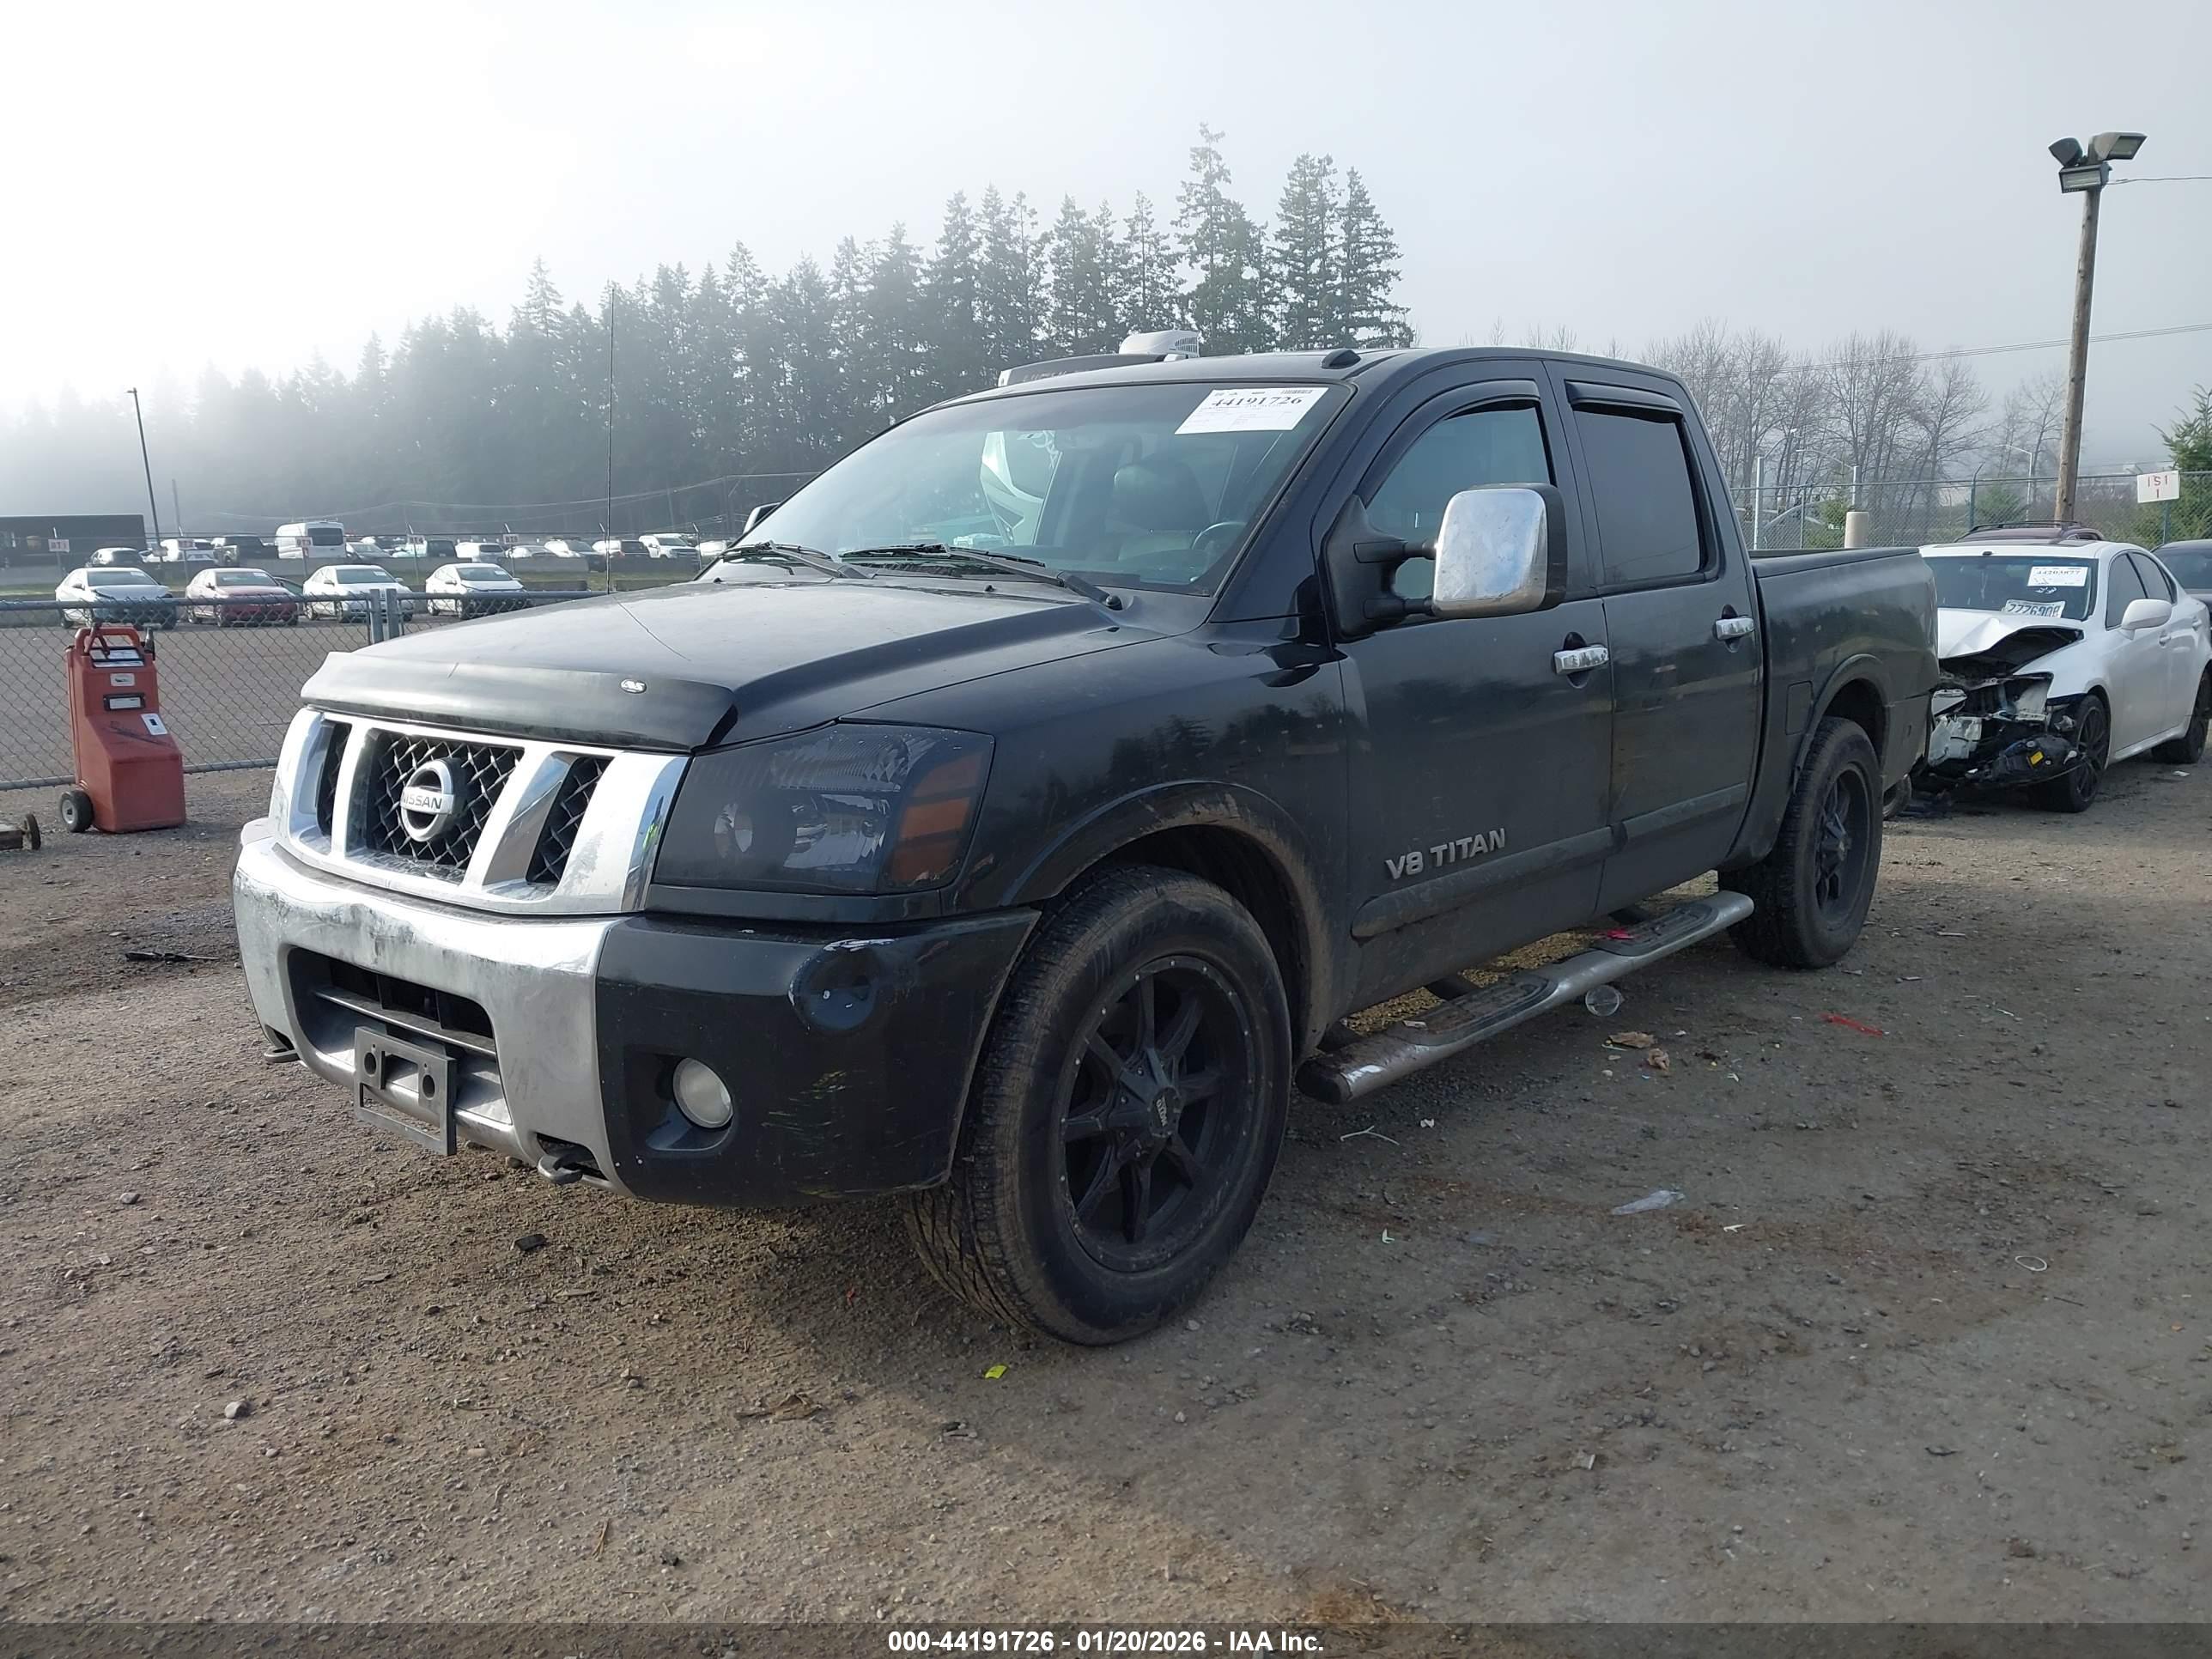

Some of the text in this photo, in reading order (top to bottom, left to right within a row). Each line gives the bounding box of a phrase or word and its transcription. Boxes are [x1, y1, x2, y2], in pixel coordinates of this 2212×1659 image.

[1212, 396, 1304, 407] 44191726
[403, 793, 443, 810] NISSAN
[1385, 828, 1505, 880] V8 TITAN
